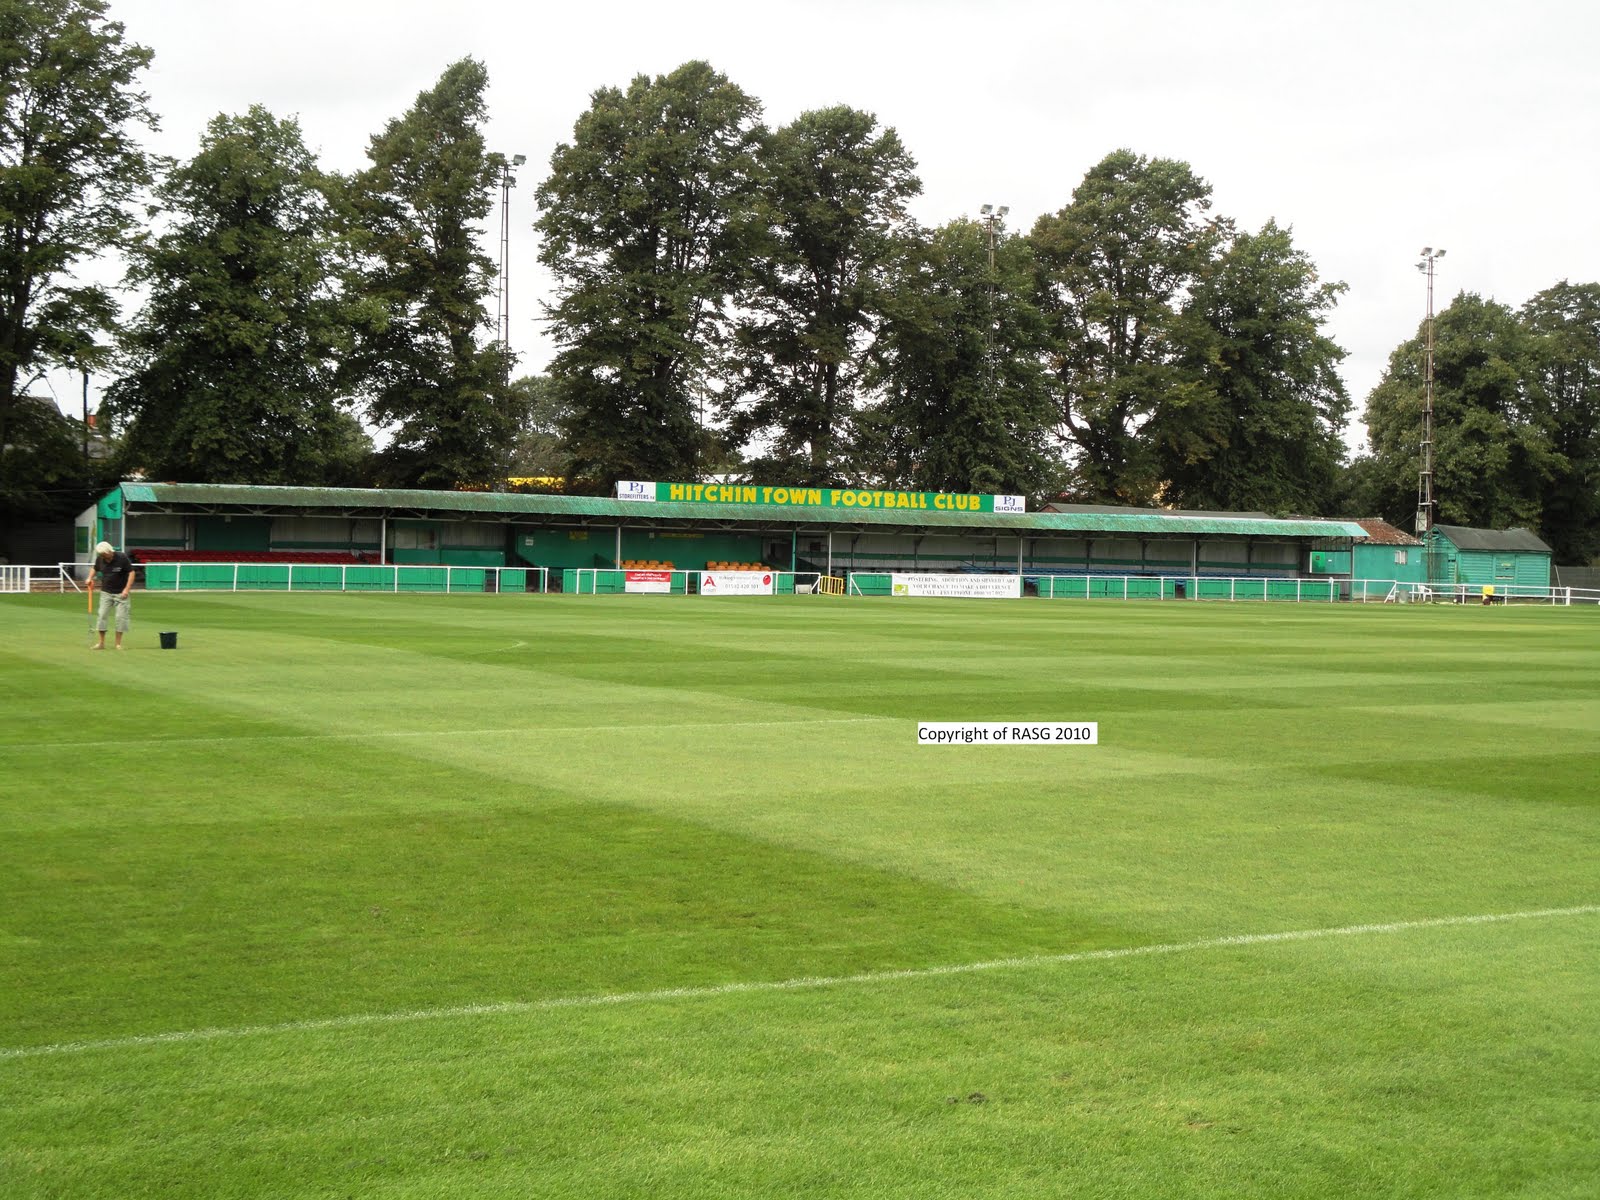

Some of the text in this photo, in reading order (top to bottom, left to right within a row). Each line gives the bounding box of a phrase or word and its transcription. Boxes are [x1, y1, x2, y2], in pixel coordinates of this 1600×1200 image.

[670, 484, 981, 510] HITCHIN TOWN FOOTBALL CLUB
